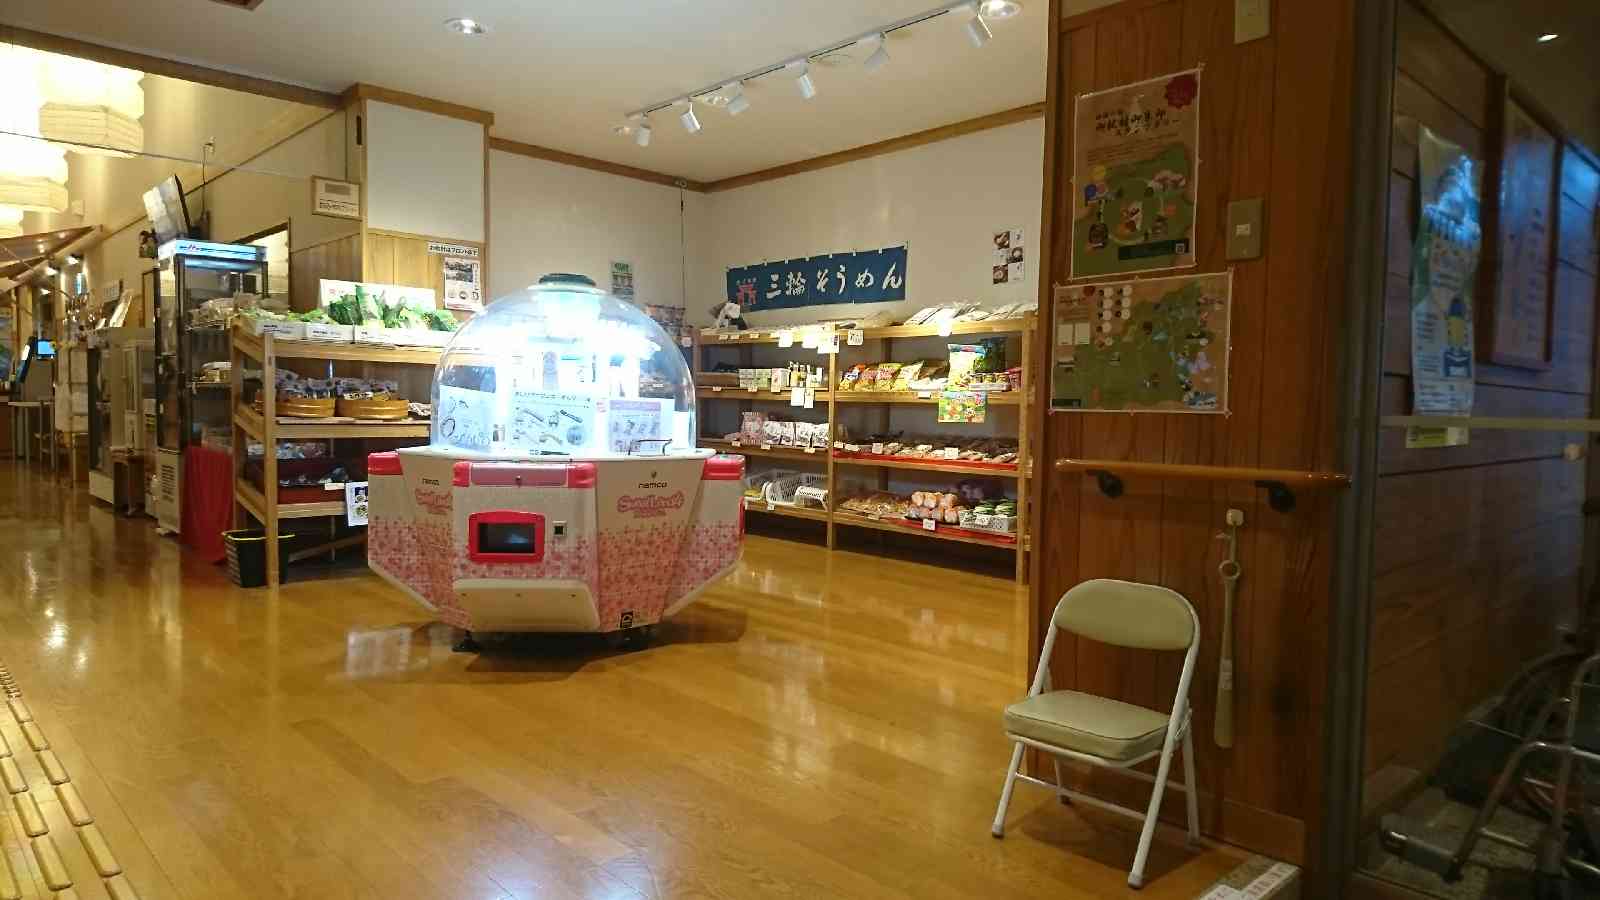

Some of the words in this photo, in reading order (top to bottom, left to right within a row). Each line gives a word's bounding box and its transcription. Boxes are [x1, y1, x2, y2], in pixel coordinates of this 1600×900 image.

[766, 261, 903, 299] 三輪そうめん
[638, 481, 668, 489] namco
